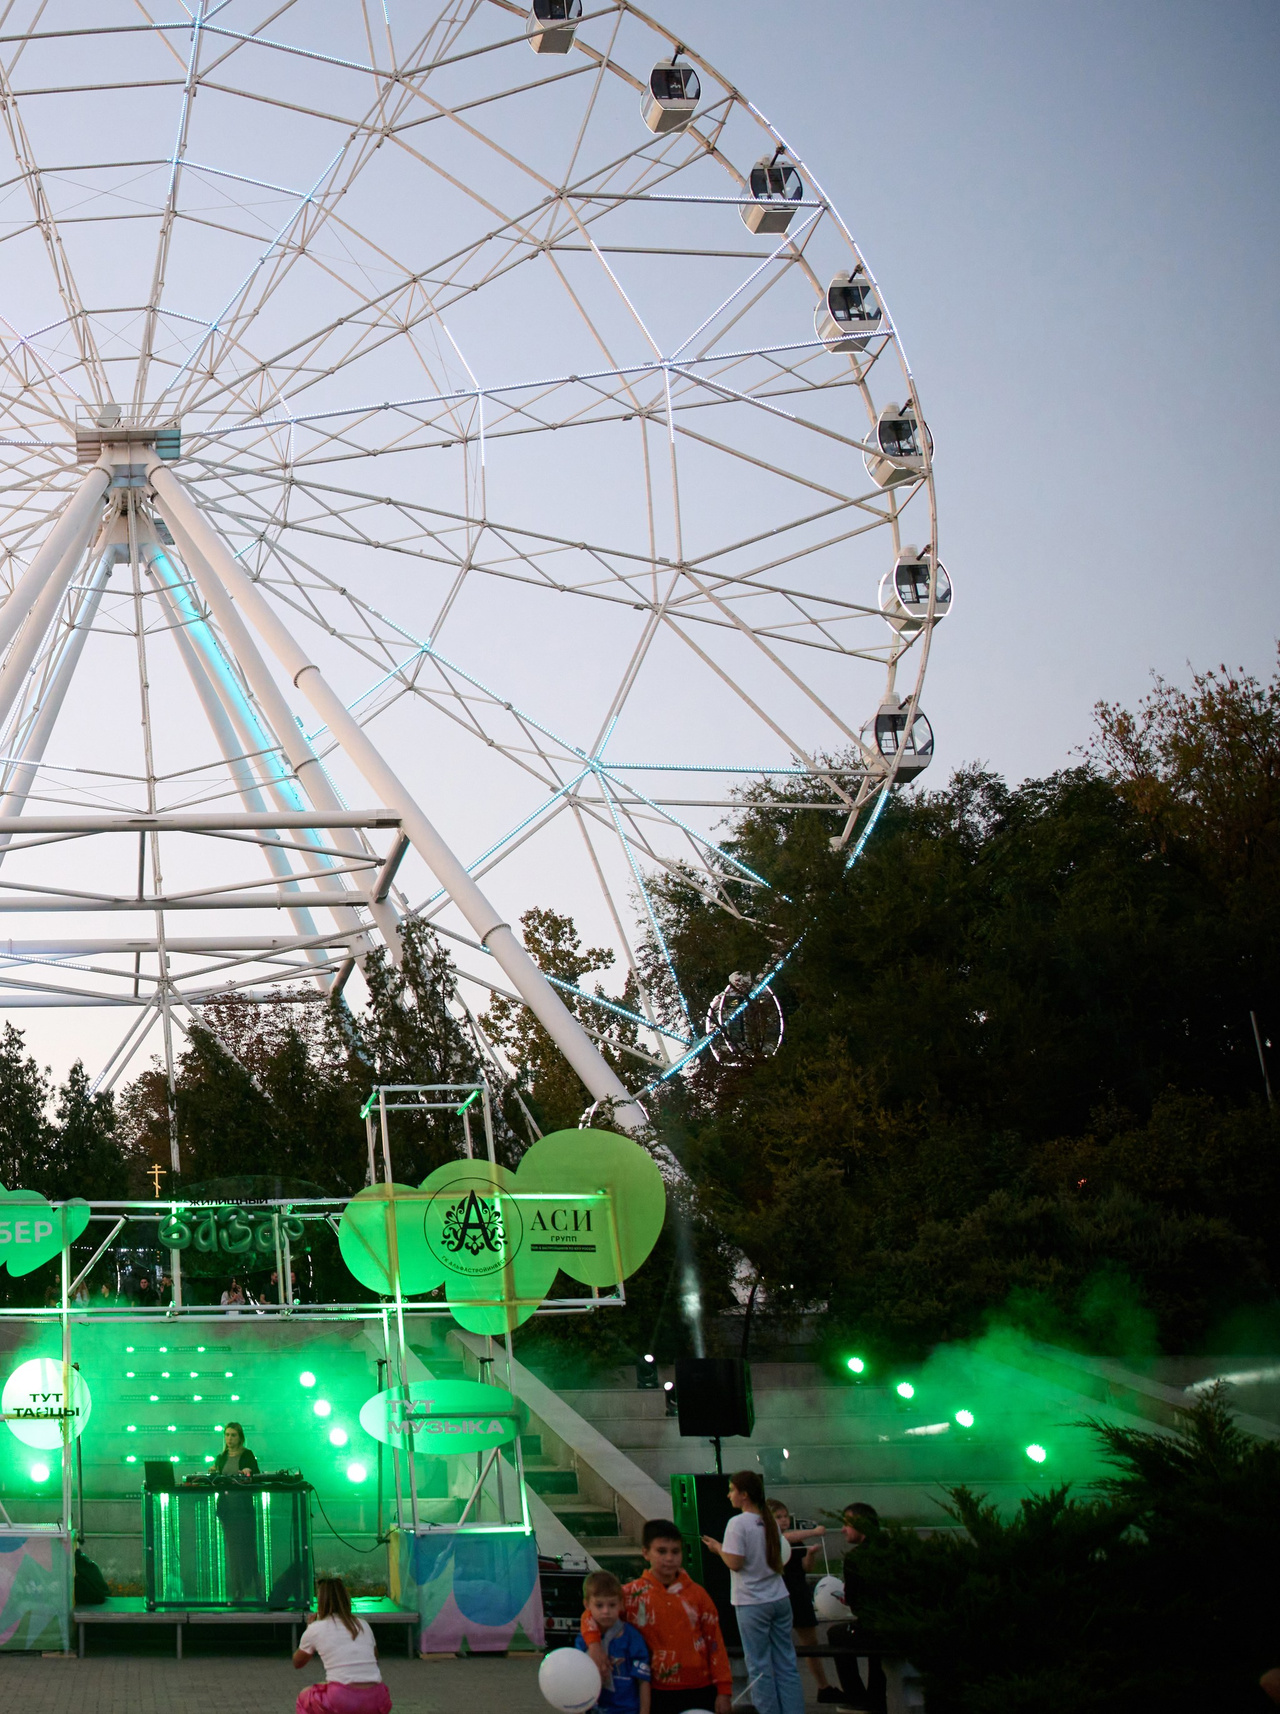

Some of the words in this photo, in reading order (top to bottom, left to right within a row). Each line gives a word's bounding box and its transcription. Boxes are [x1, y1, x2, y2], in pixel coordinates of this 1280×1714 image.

[530, 1209, 593, 1232] АСИ
[551, 1235, 577, 1243] ГРУПП
[29, 1393, 63, 1402] ТУТ
[386, 1400, 435, 1413] ТУТ
[387, 1420, 504, 1434] МУЗЫКА
